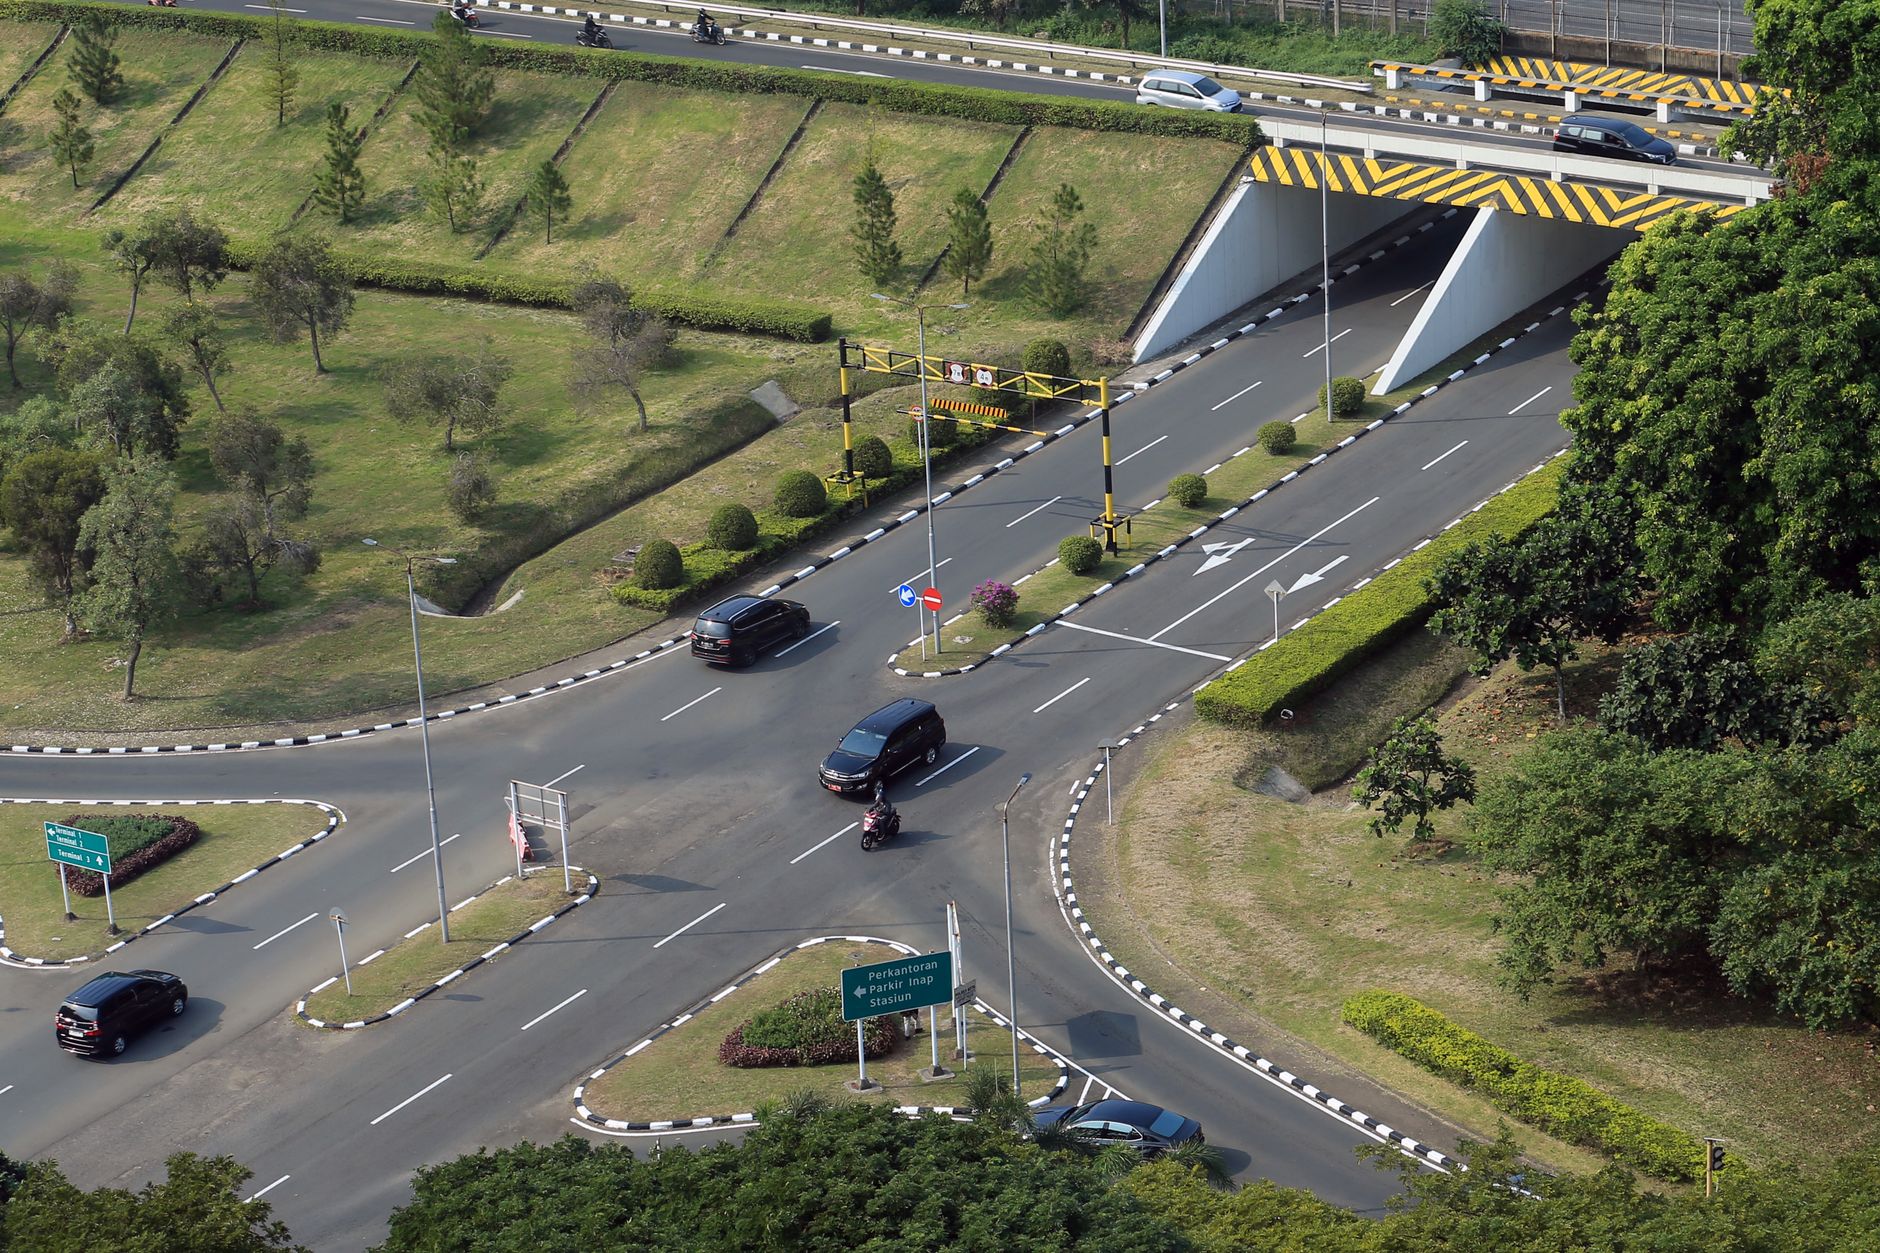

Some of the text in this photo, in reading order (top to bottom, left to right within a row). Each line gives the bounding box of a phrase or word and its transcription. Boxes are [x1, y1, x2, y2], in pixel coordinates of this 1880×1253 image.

[55, 826, 76, 837] Terminal
[56, 834, 77, 846] Terminal
[58, 849, 82, 861] Terminal
[868, 961, 938, 981] Perkantoran
[869, 975, 934, 994] Parkir Inap
[870, 993, 912, 1008] Stasiun
